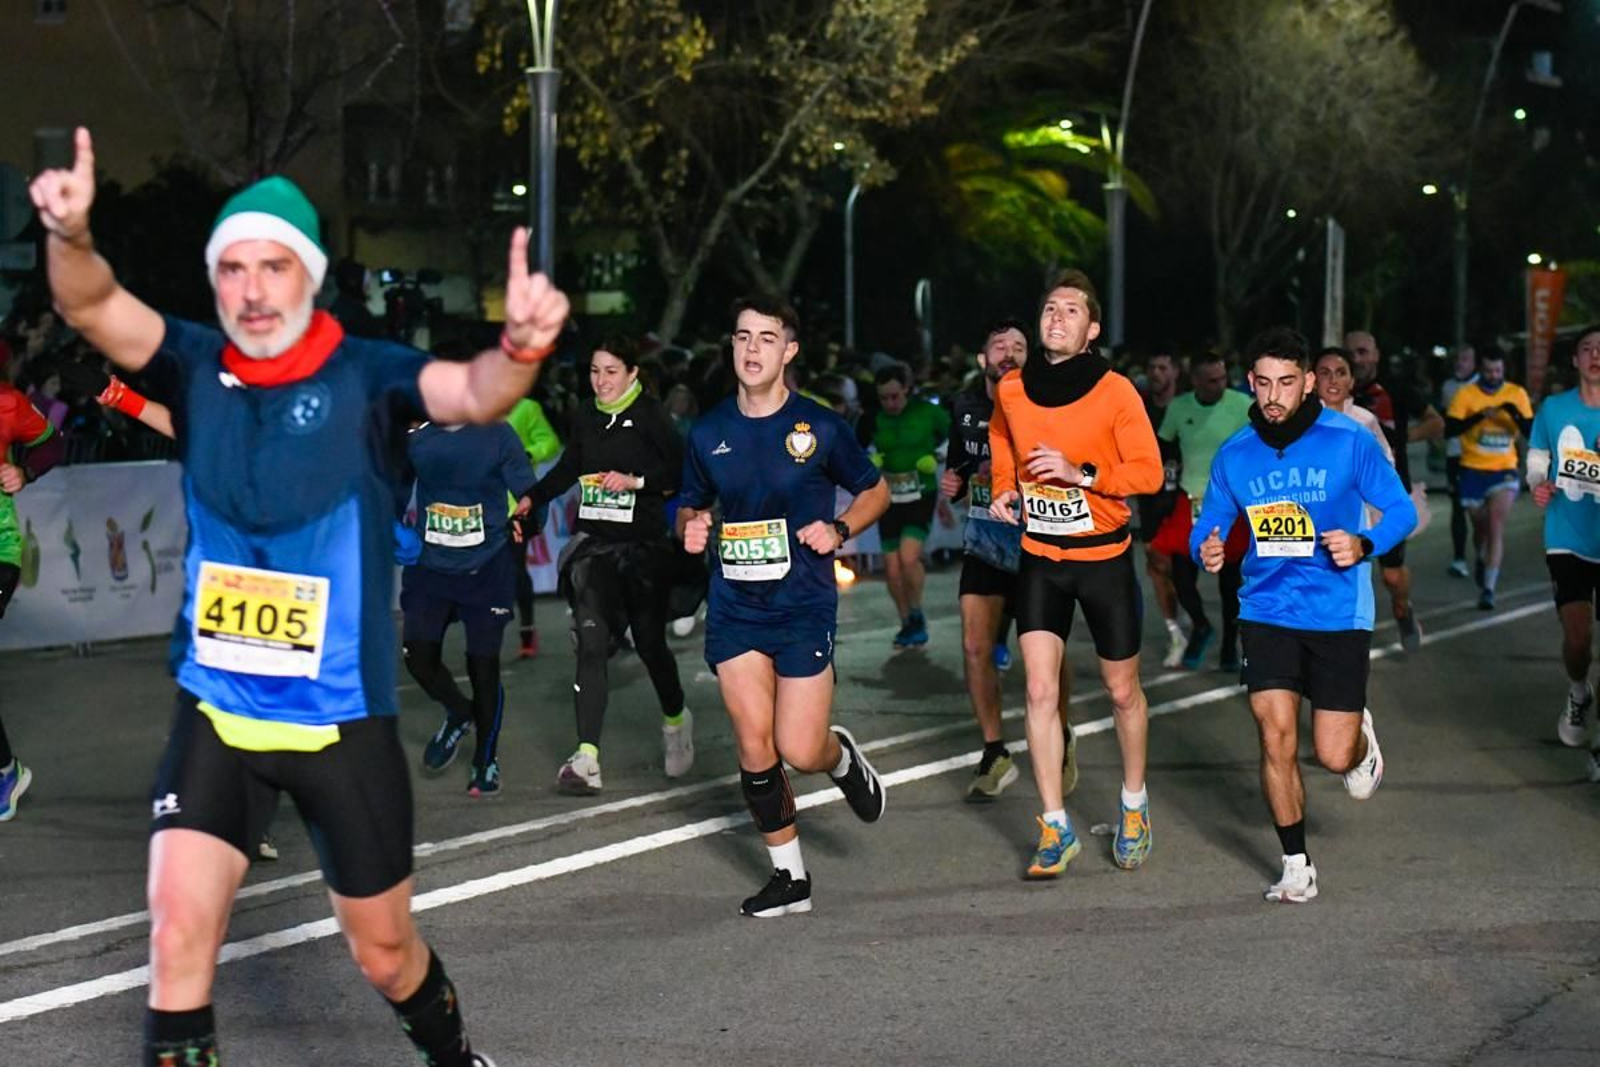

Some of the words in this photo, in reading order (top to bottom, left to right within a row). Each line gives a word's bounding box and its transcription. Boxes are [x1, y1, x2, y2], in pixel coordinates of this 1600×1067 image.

[1248, 467, 1327, 497] UCAM
[586, 486, 630, 506] 1129
[1026, 497, 1084, 517] 10167
[431, 514, 477, 533] 1013
[1258, 516, 1307, 536] 4201
[720, 536, 782, 560] 2053
[205, 596, 308, 639] 4105
